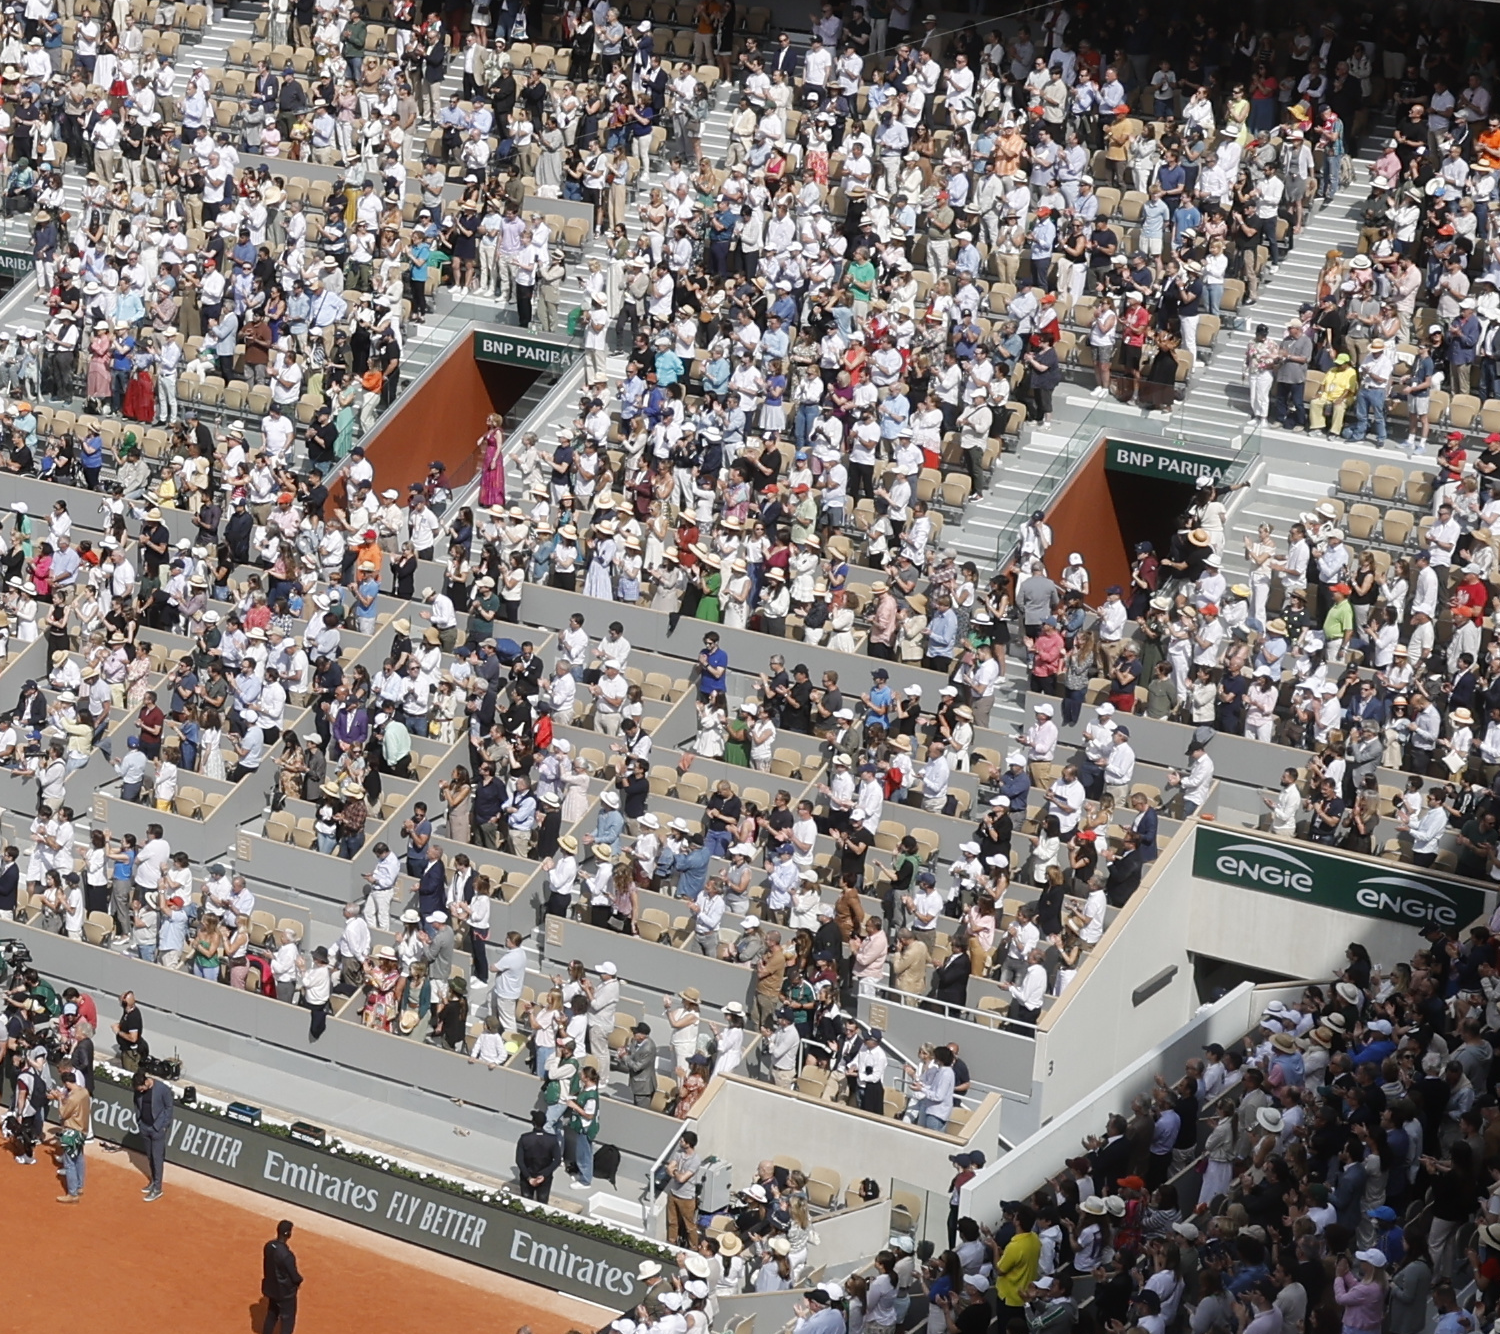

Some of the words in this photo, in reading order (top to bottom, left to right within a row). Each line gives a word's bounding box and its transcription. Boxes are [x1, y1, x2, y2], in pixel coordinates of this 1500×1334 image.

[482, 339, 514, 356] BNP
[1116, 449, 1154, 467] BNP
[1048, 1059, 1054, 1077] 3
[90, 1097, 141, 1136] rates
[180, 1123, 243, 1169] BETTER
[263, 1149, 379, 1213] Emirates
[386, 1190, 422, 1226] FLY
[419, 1201, 488, 1249] BETTER
[510, 1229, 635, 1296] Emirates
